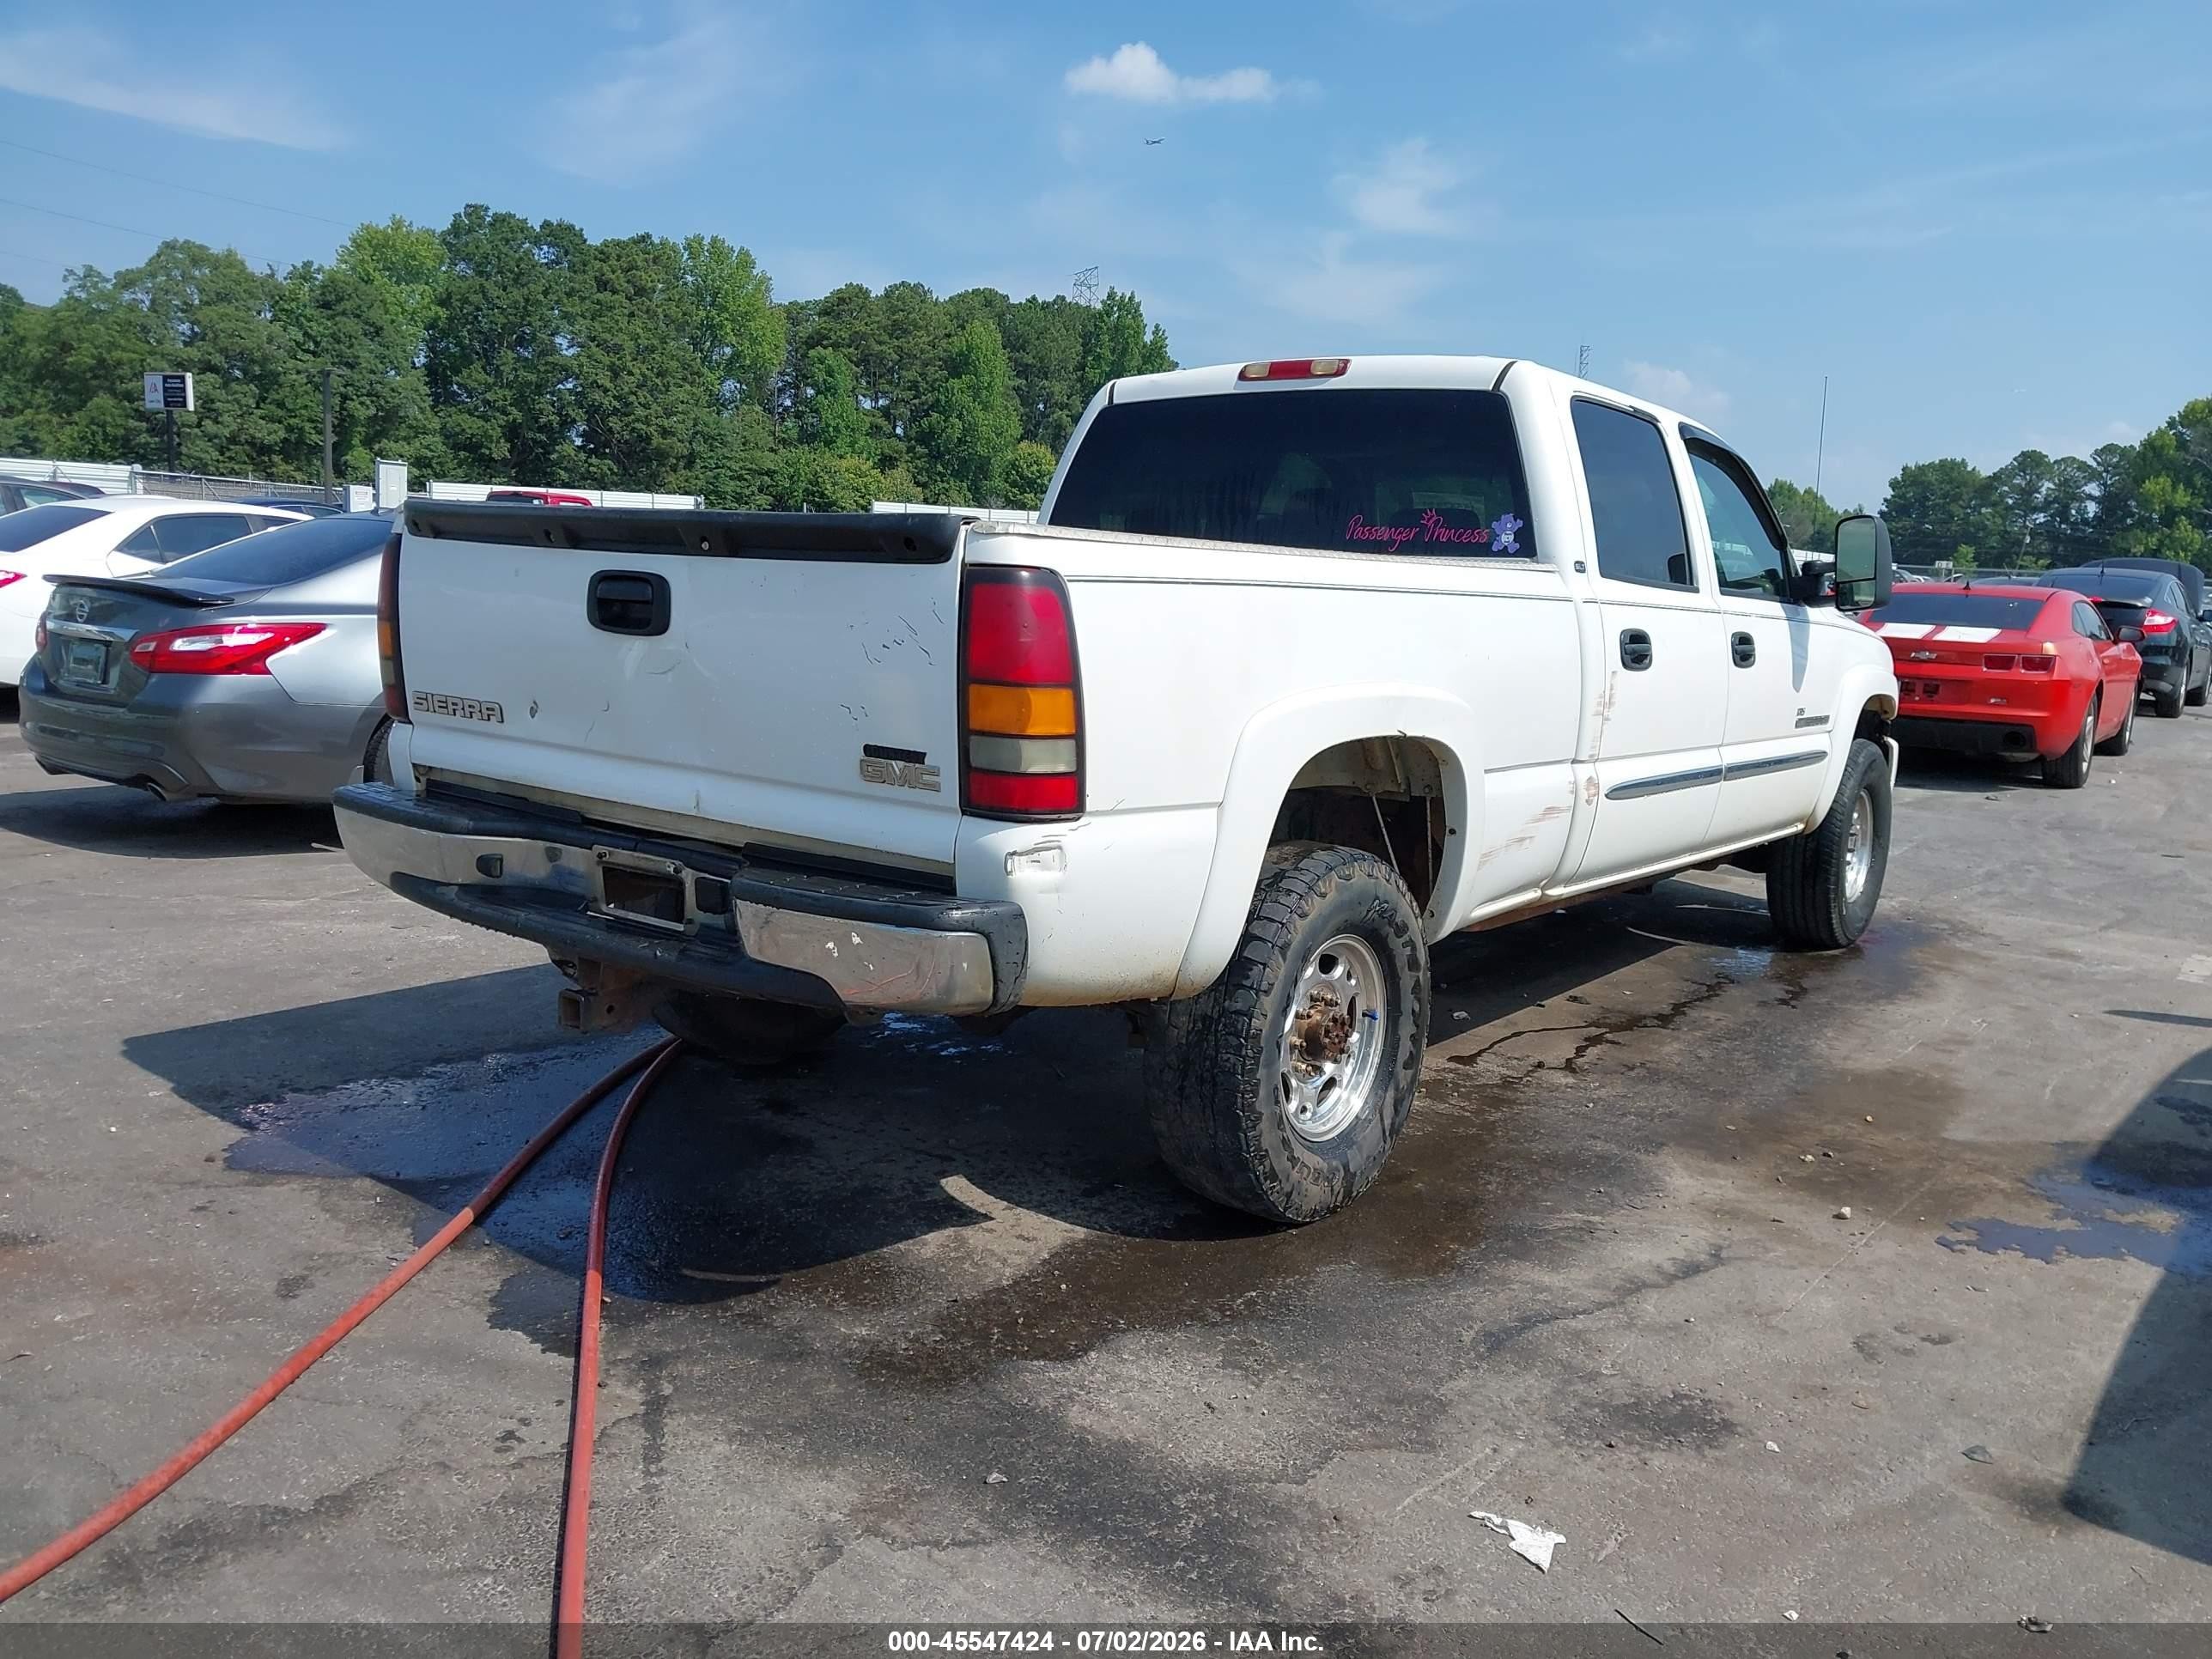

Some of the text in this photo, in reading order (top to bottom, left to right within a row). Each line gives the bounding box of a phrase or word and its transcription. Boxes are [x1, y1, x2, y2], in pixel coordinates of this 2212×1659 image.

[1346, 515, 1491, 552] Passenger Princess
[411, 690, 504, 723] SIERRA
[860, 757, 941, 792] GMC
